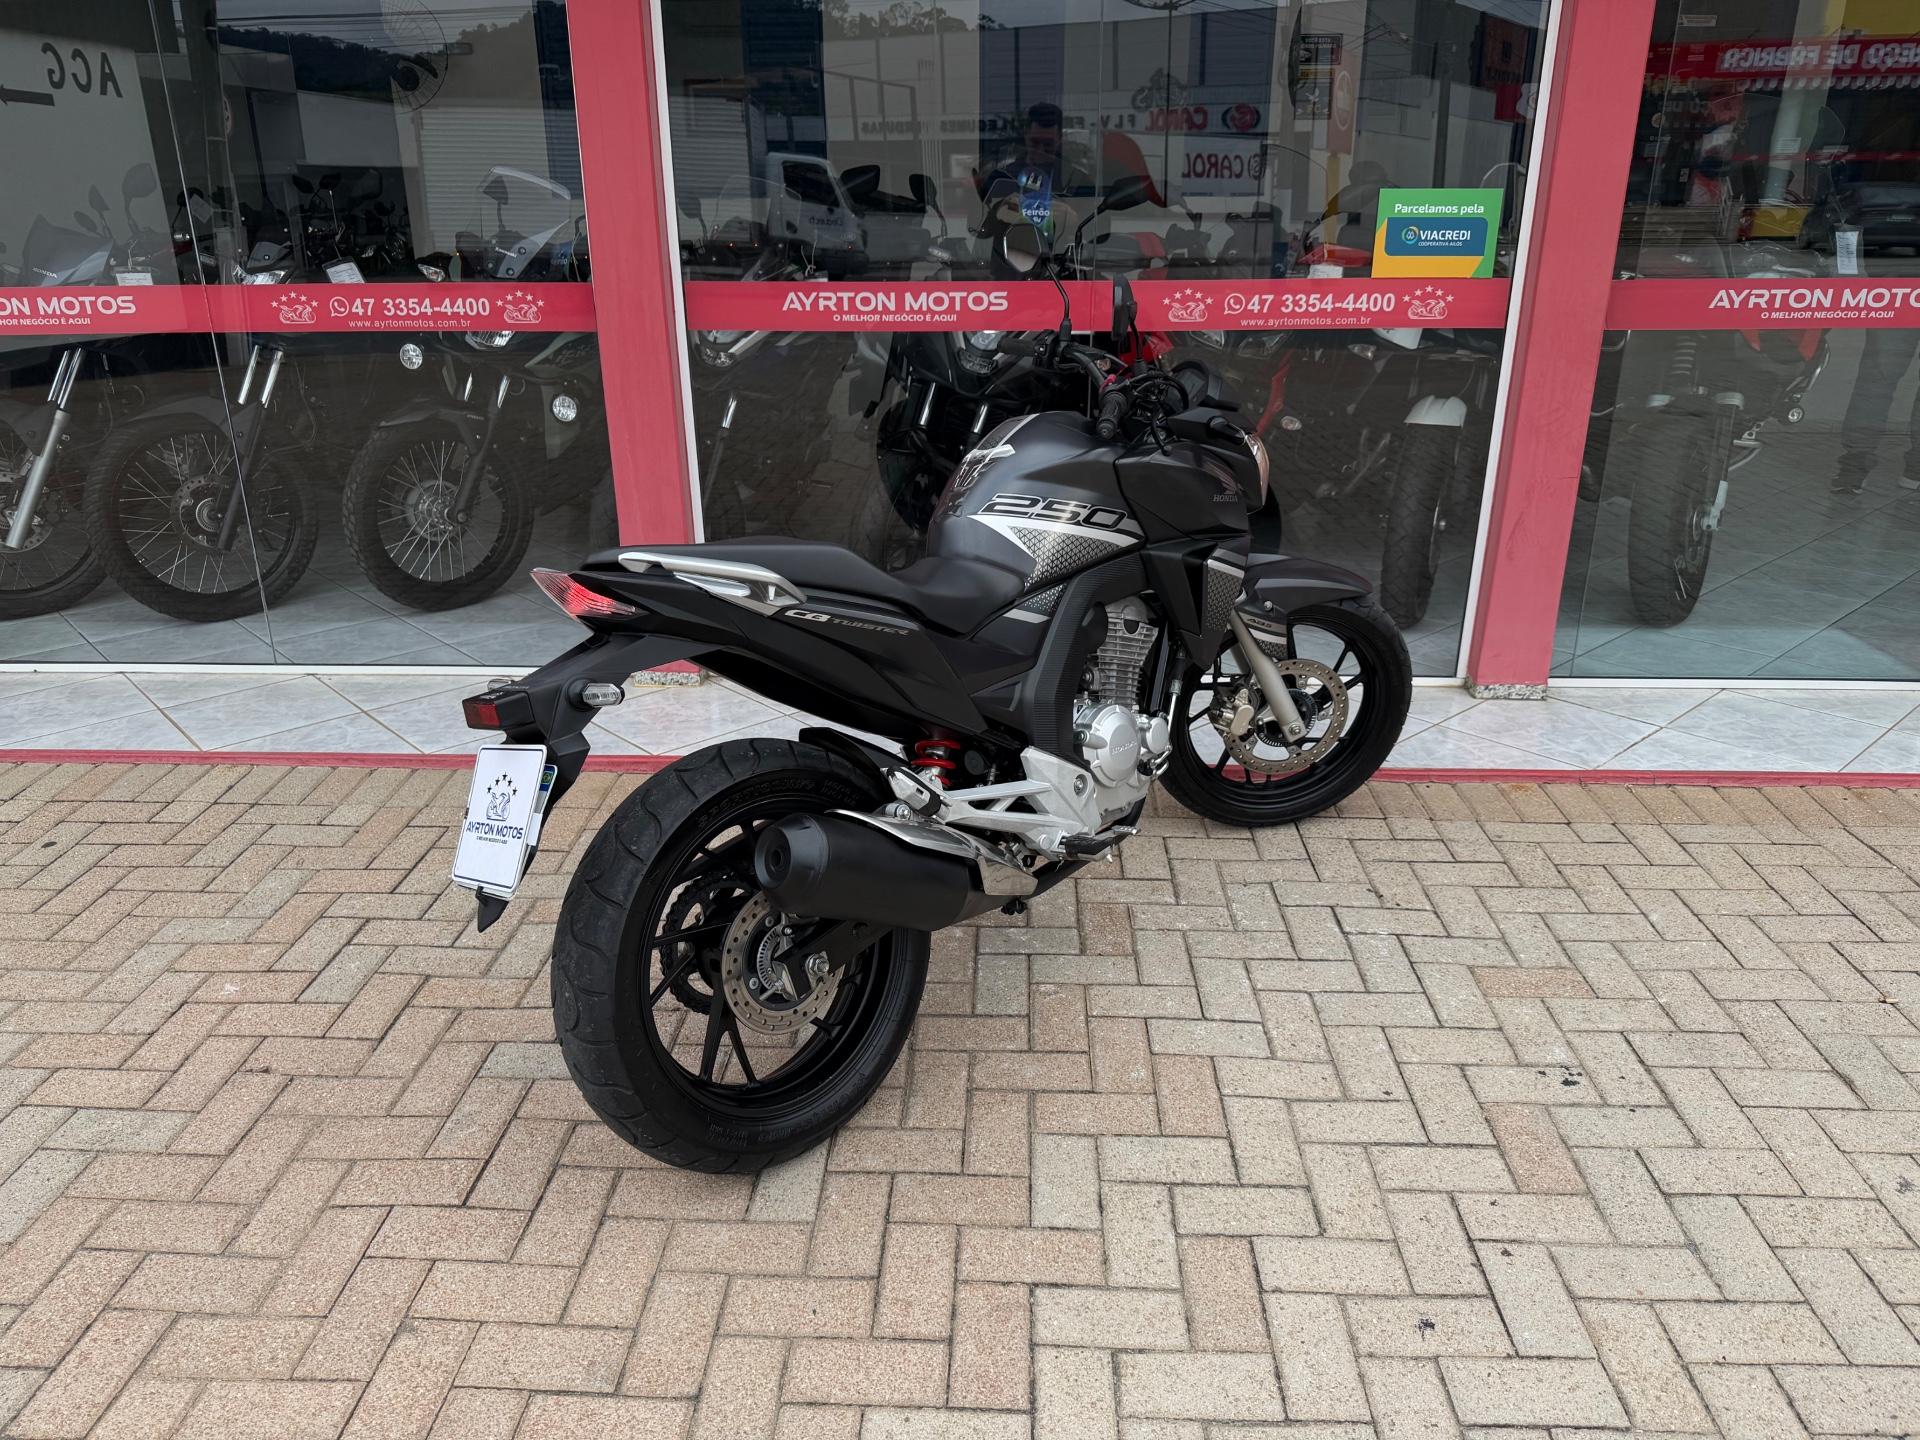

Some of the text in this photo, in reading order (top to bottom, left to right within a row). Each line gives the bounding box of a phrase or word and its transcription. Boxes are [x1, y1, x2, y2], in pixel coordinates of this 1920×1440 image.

[1394, 203, 1485, 215] Parcelamos pela
[1420, 230, 1471, 240] VIACREDI
[37, 295, 136, 315] MOTOS
[782, 291, 1009, 311] AYRTON MOTOS
[1247, 293, 1396, 313] 47 3354-4400
[1708, 288, 1834, 308] AYRTON
[351, 297, 490, 317] 47 3354-4400
[1761, 309, 1895, 319] O MELHOR NEGÓCIO É AQUI
[20, 316, 60, 326] NEGÓCIO
[61, 316, 67, 325] É
[68, 317, 91, 325] AQUI
[348, 319, 471, 329] www.ayrtonmotos.com.br
[833, 312, 957, 322] O MELHOR NEGÓCIO É AQUI
[1240, 316, 1371, 327] www.ayrtonmotos.com.br
[1213, 494, 1238, 502] HONDA
[978, 493, 1127, 530] 250
[784, 609, 910, 635] CB TWISTER
[466, 821, 495, 836] AYRTON
[495, 824, 524, 840] MOTOS
